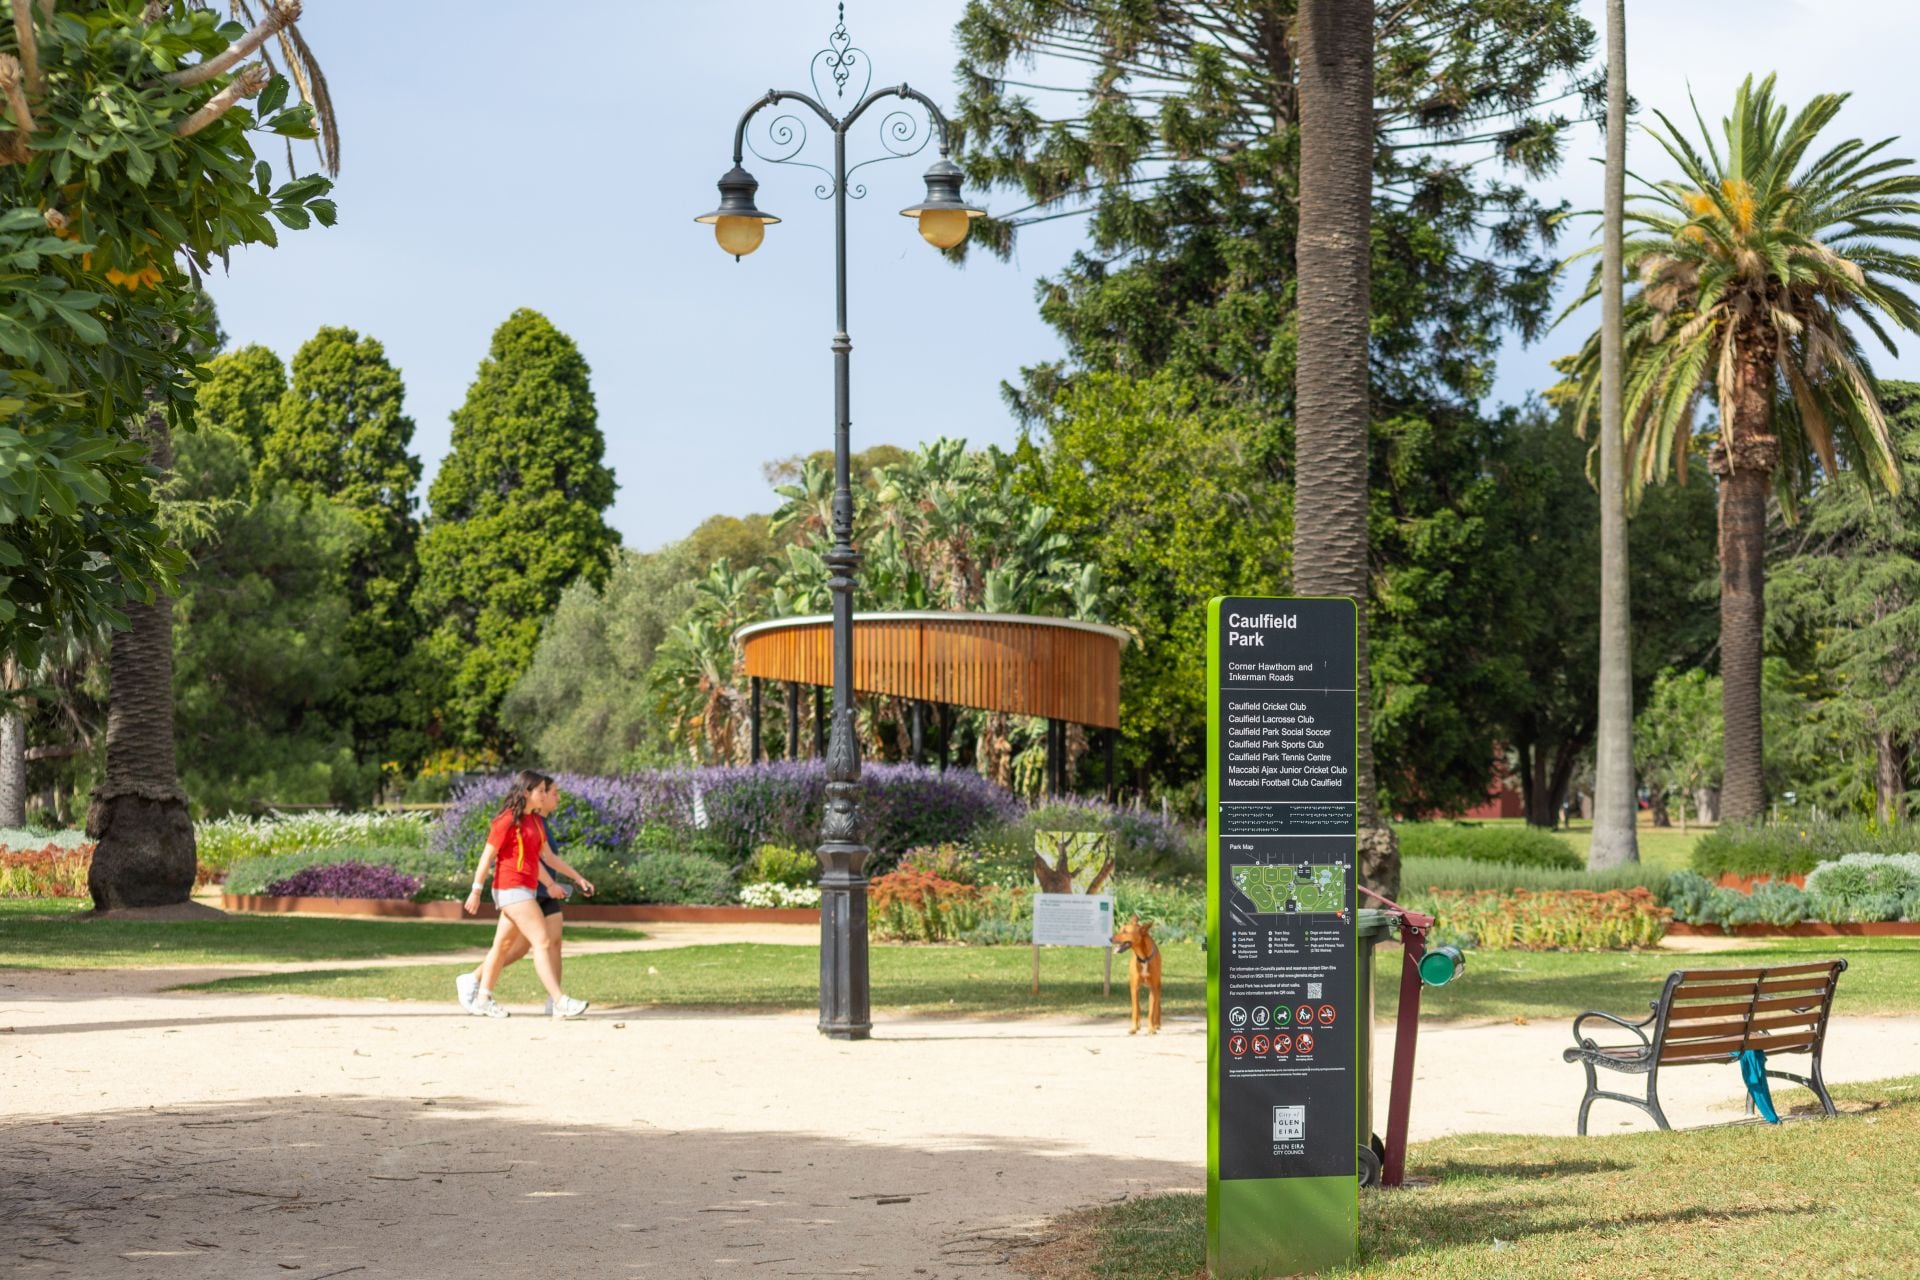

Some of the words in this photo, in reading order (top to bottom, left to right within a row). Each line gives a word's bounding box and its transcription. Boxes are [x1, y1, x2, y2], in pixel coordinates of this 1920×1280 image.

[1228, 613, 1297, 629] Caulfield
[1228, 632, 1264, 646] Park
[1228, 662, 1255, 671] Corner
[1258, 662, 1295, 671] Hawthorn
[1298, 662, 1313, 671] and
[1229, 673, 1266, 681] Inkerman
[1269, 673, 1294, 681] Roads
[1228, 702, 1260, 711] Caulfield
[1262, 702, 1288, 711] Cricket
[1290, 702, 1306, 711] Club
[1228, 715, 1260, 723] Caulfield
[1262, 715, 1295, 723] Lacrosse
[1298, 715, 1314, 723] Club
[1228, 727, 1260, 736] Caulfield
[1262, 727, 1279, 736] Park
[1281, 727, 1304, 736] Social
[1306, 727, 1331, 736] Soccer
[1228, 740, 1260, 748] Caulfield
[1262, 740, 1279, 748] Park
[1281, 740, 1305, 749] Sports
[1307, 740, 1324, 748] Club
[1228, 753, 1260, 761] Caulfield
[1262, 753, 1279, 761] Park
[1282, 753, 1305, 761] Tennis
[1307, 753, 1331, 761] Centre
[1228, 766, 1259, 774] Maccabi
[1261, 766, 1277, 775] Ajax
[1280, 766, 1302, 774] Junior
[1304, 766, 1329, 774] Cricket
[1331, 766, 1347, 774] Club
[1228, 778, 1259, 787] Maccabi
[1262, 778, 1289, 787] Football
[1292, 778, 1308, 787] Club
[1311, 778, 1342, 787] Caulfield
